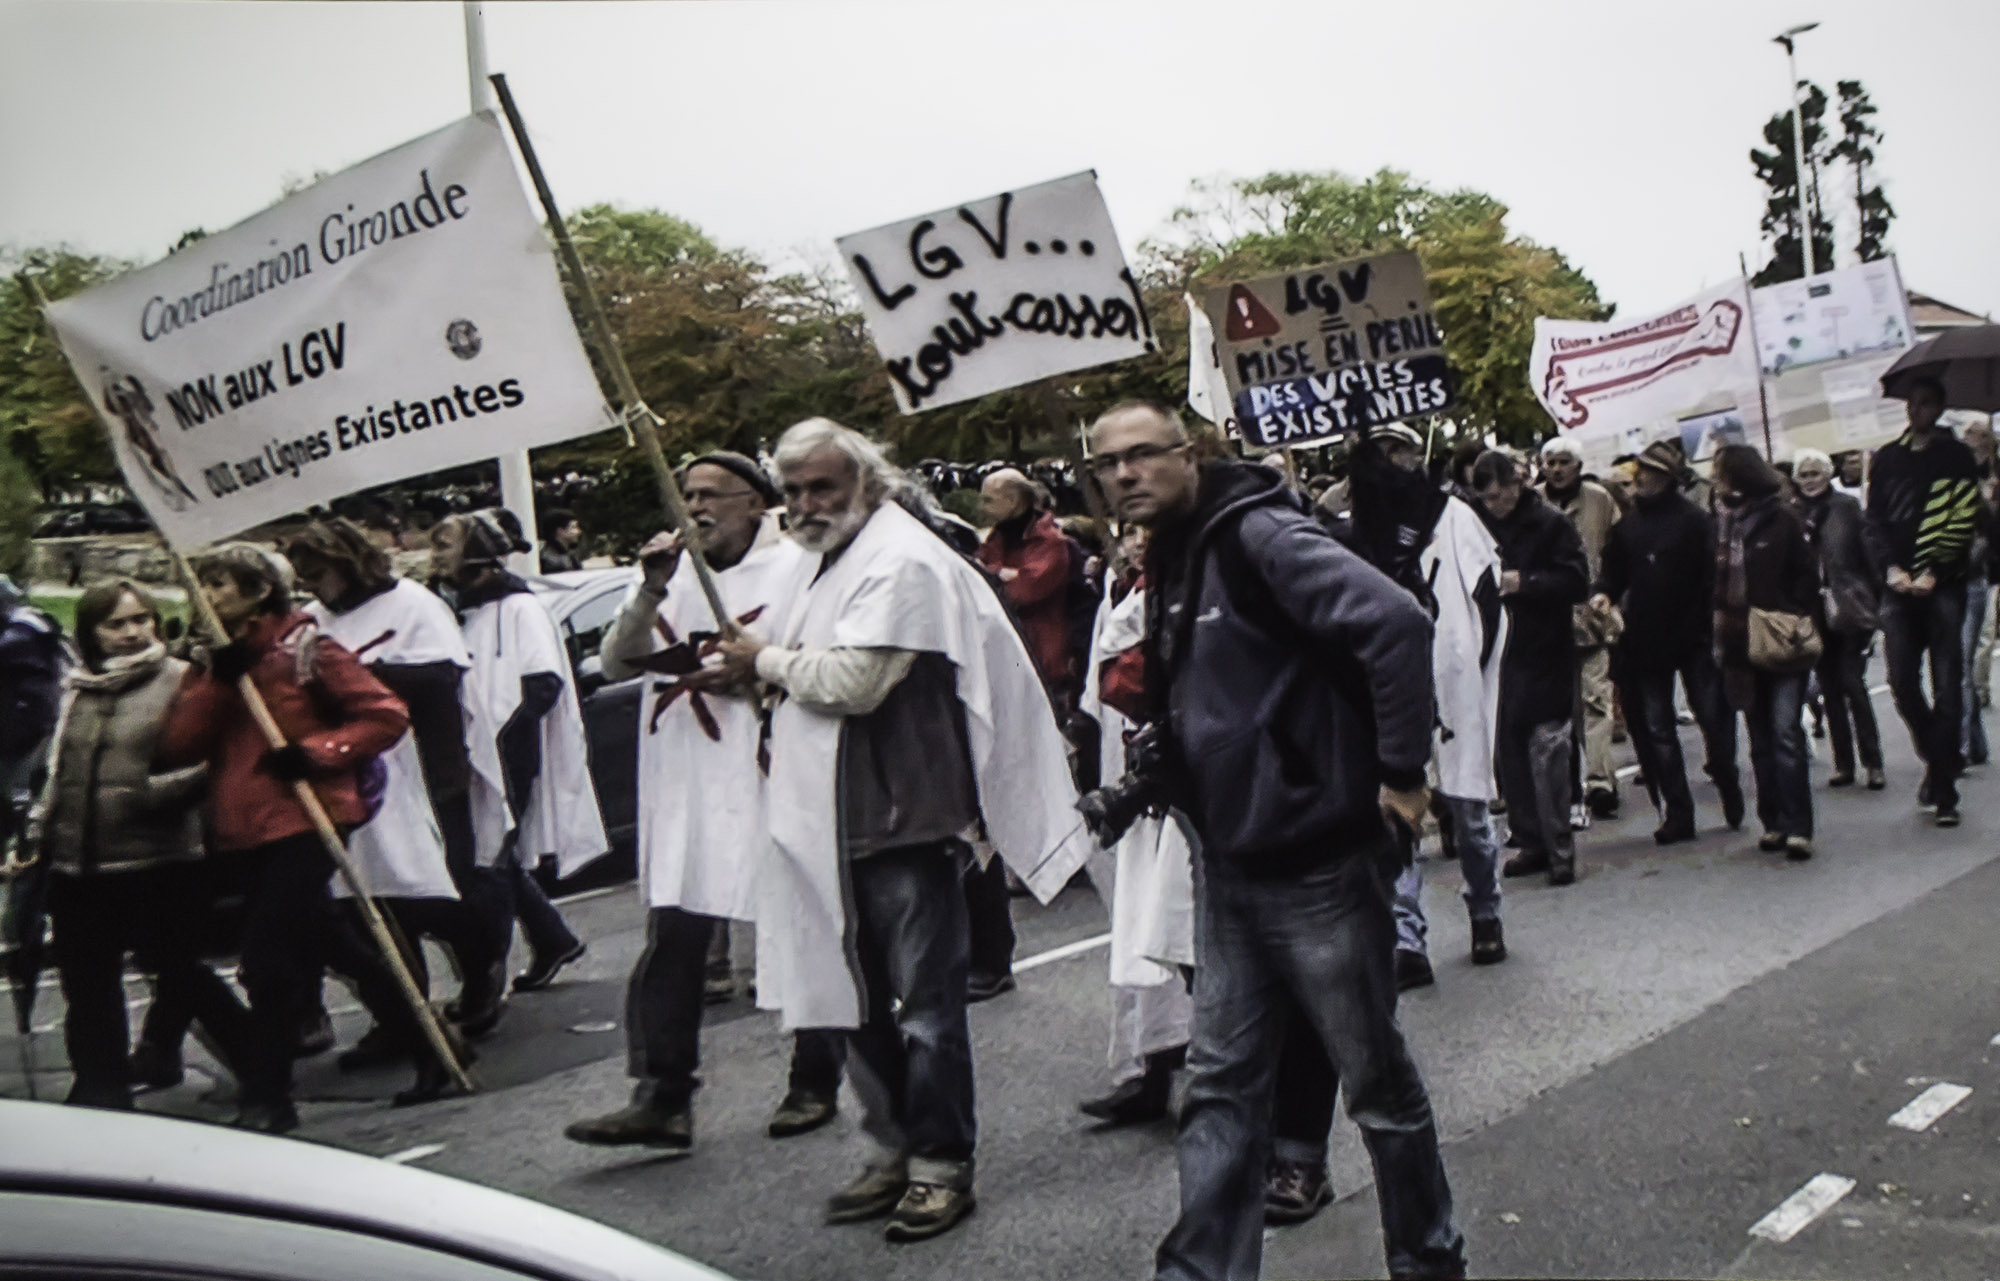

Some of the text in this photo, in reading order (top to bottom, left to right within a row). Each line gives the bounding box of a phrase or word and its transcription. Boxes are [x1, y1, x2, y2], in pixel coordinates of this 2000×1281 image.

[141, 169, 469, 342] Coordination Gironde
[1285, 262, 1370, 315] LGV
[166, 321, 345, 431] NON aux LGV
[1324, 332, 1359, 367] EN
[235, 455, 270, 487] aux
[264, 430, 331, 478] Lignes
[335, 378, 525, 451] Existantes
[1250, 382, 1301, 416] DES
